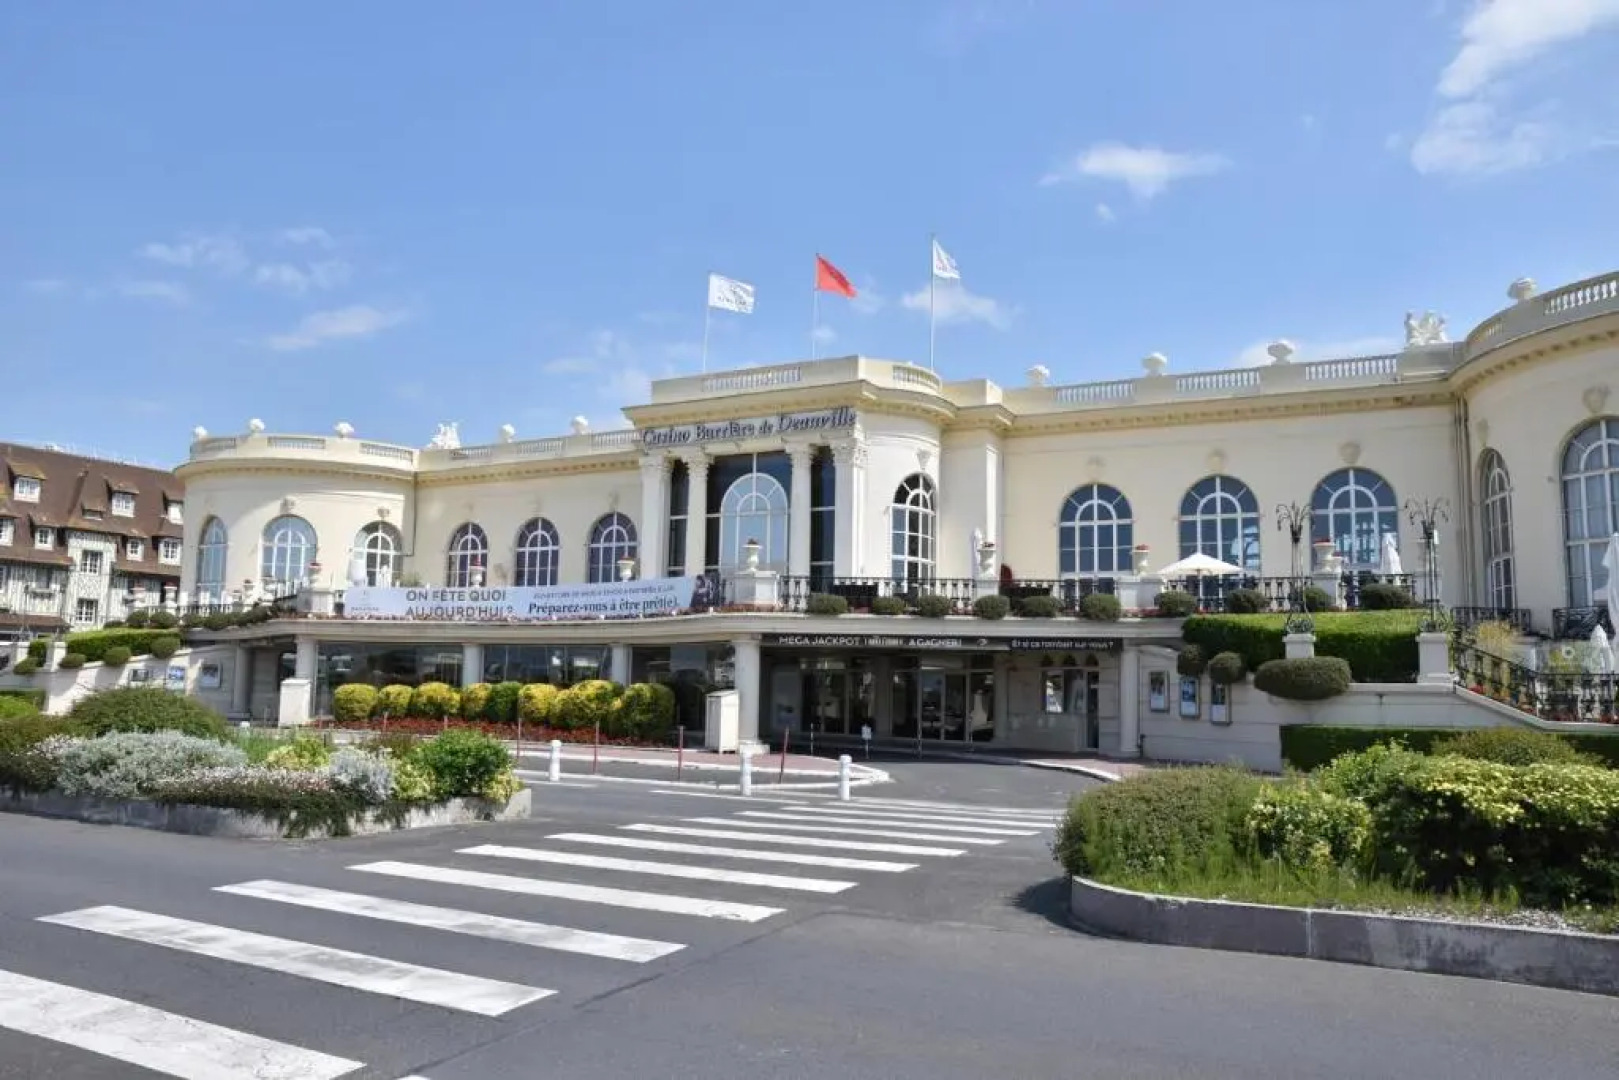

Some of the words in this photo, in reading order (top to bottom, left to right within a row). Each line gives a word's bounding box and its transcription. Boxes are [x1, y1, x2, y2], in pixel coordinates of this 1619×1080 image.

[643, 425, 692, 446] Casino
[759, 418, 774, 434] de
[406, 590, 428, 602] ON
[432, 588, 465, 602] FÊTE
[469, 589, 507, 602] QUOI
[405, 605, 503, 618] AUJOURD'HUI
[528, 601, 608, 616] Préparez-vous
[812, 636, 860, 646] JACKPOT
